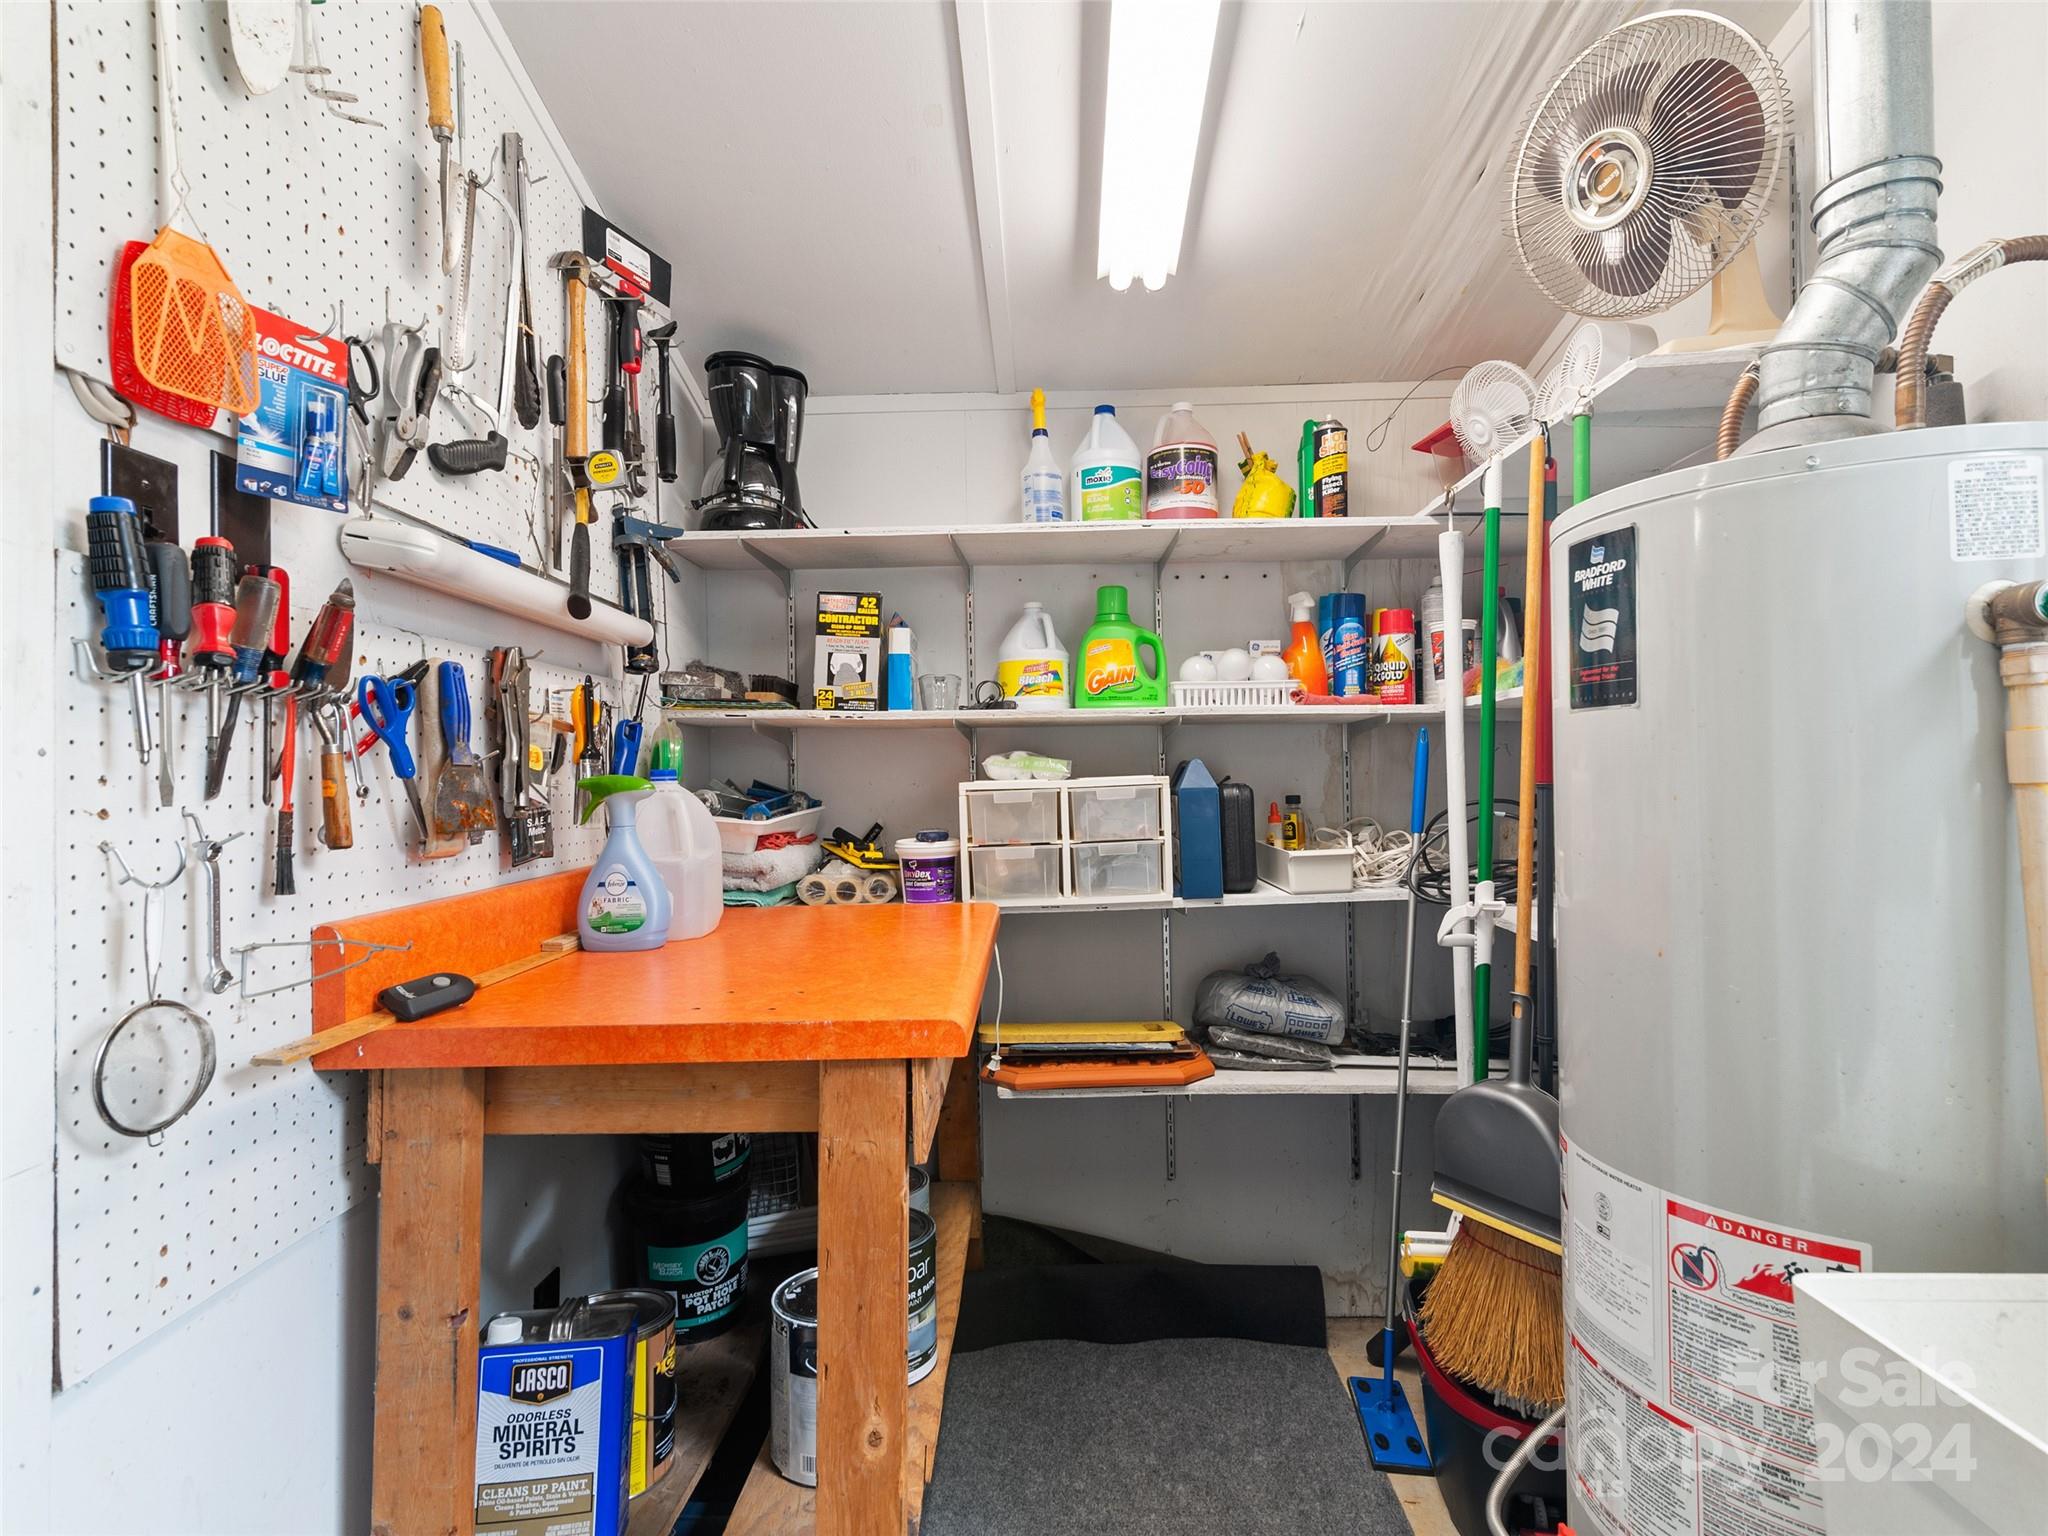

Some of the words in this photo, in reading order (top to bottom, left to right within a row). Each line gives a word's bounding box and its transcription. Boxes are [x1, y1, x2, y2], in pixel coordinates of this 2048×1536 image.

[258, 359, 289, 374] SUPER
[258, 366, 288, 384] GLUE
[1319, 441, 1349, 458] SHO
[1085, 475, 1112, 485] moxie
[1321, 474, 1343, 485] Flying
[1321, 479, 1344, 491] Insect
[1321, 486, 1341, 496] Killer
[1574, 558, 1627, 583] BRADFORD
[1582, 573, 1615, 592] WHITE
[149, 573, 158, 627] CRAFTSMAN
[860, 596, 877, 609] 42
[818, 613, 879, 626] CONTRACTOR
[857, 607, 879, 615] GALLON
[1018, 672, 1054, 686] Bleach
[1088, 666, 1137, 694] GAIN
[818, 690, 834, 699] 24
[603, 896, 630, 904] FABRIC
[1230, 1010, 1267, 1029] LOWE'S
[1288, 1026, 1324, 1039] LOWE'S
[1609, 1172, 1623, 1184] WATER
[1623, 1179, 1642, 1192] HEATER
[1722, 1221, 1809, 1253] DANGER
[682, 1287, 714, 1300] BLACKTOP
[685, 1295, 710, 1309] POT
[712, 1280, 739, 1301] HOLE
[696, 1294, 731, 1315] PATCH
[1731, 1292, 1769, 1309] Flammable
[1770, 1304, 1796, 1317] Vapors
[515, 1365, 568, 1393] JASCO
[507, 1408, 572, 1424] ODORLESS
[493, 1418, 585, 1443] MINERAL
[499, 1436, 576, 1460] SPIRITS
[1760, 1460, 1791, 1477] WARNING
[478, 1499, 496, 1507] Thins
[524, 1494, 544, 1503] Paints,
[545, 1492, 561, 1500] Stain
[568, 1488, 591, 1497] Varnish
[482, 1485, 529, 1500] CLEANS
[532, 1482, 549, 1495] UP
[551, 1478, 588, 1492] PAINT
[494, 1503, 514, 1512] Cleans
[515, 1501, 541, 1509] Brushes,
[541, 1497, 575, 1507] Equipment
[515, 1508, 531, 1516] Paint
